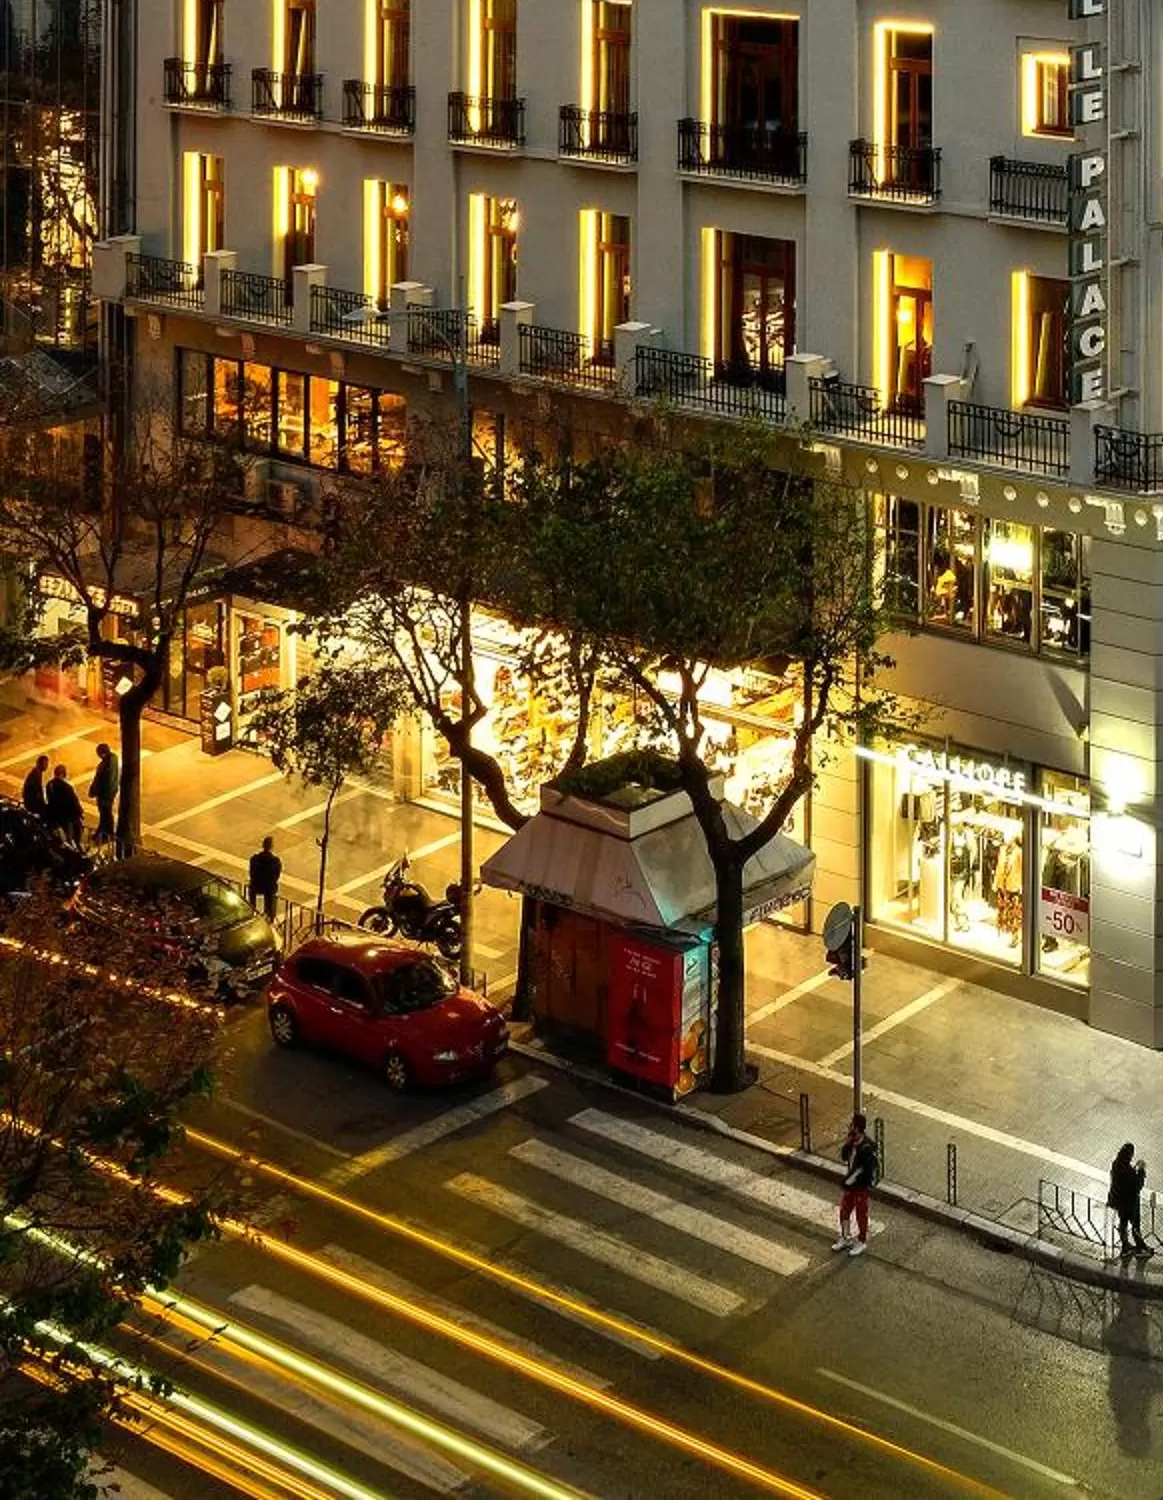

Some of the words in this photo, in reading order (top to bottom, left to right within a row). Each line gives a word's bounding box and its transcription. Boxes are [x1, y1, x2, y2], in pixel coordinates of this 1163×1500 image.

[1082, 49, 1104, 122] LE
[1079, 155, 1106, 400] PALACE
[899, 744, 1026, 794] CALLIOPE
